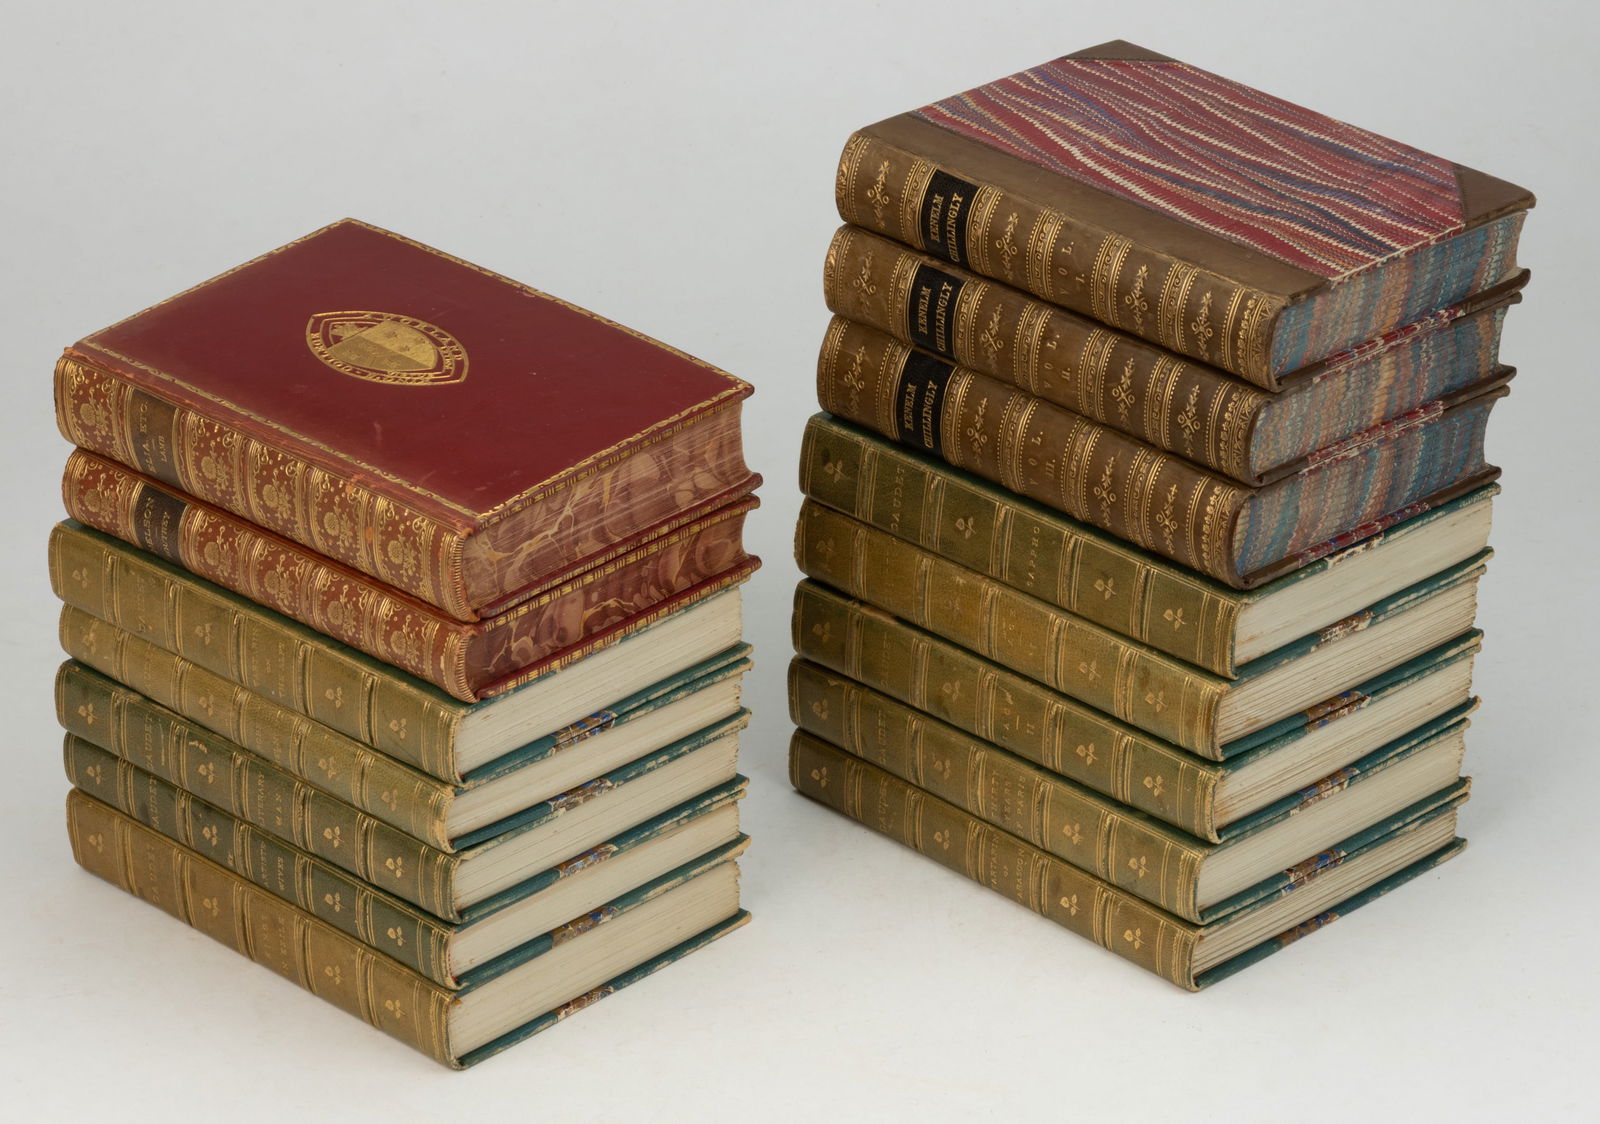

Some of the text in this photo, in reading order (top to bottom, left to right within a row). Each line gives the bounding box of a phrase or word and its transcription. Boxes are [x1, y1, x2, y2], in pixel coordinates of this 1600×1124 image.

[930, 193, 944, 243] KENELM
[946, 193, 964, 263] CHILLINGLY
[918, 287, 932, 335] KENELM
[935, 281, 953, 352] CHILLINGLY
[904, 383, 917, 432] KENELM
[923, 382, 938, 449] CHILLINGLY
[158, 435, 168, 463] LAMB
[890, 465, 904, 531] DAUDET
